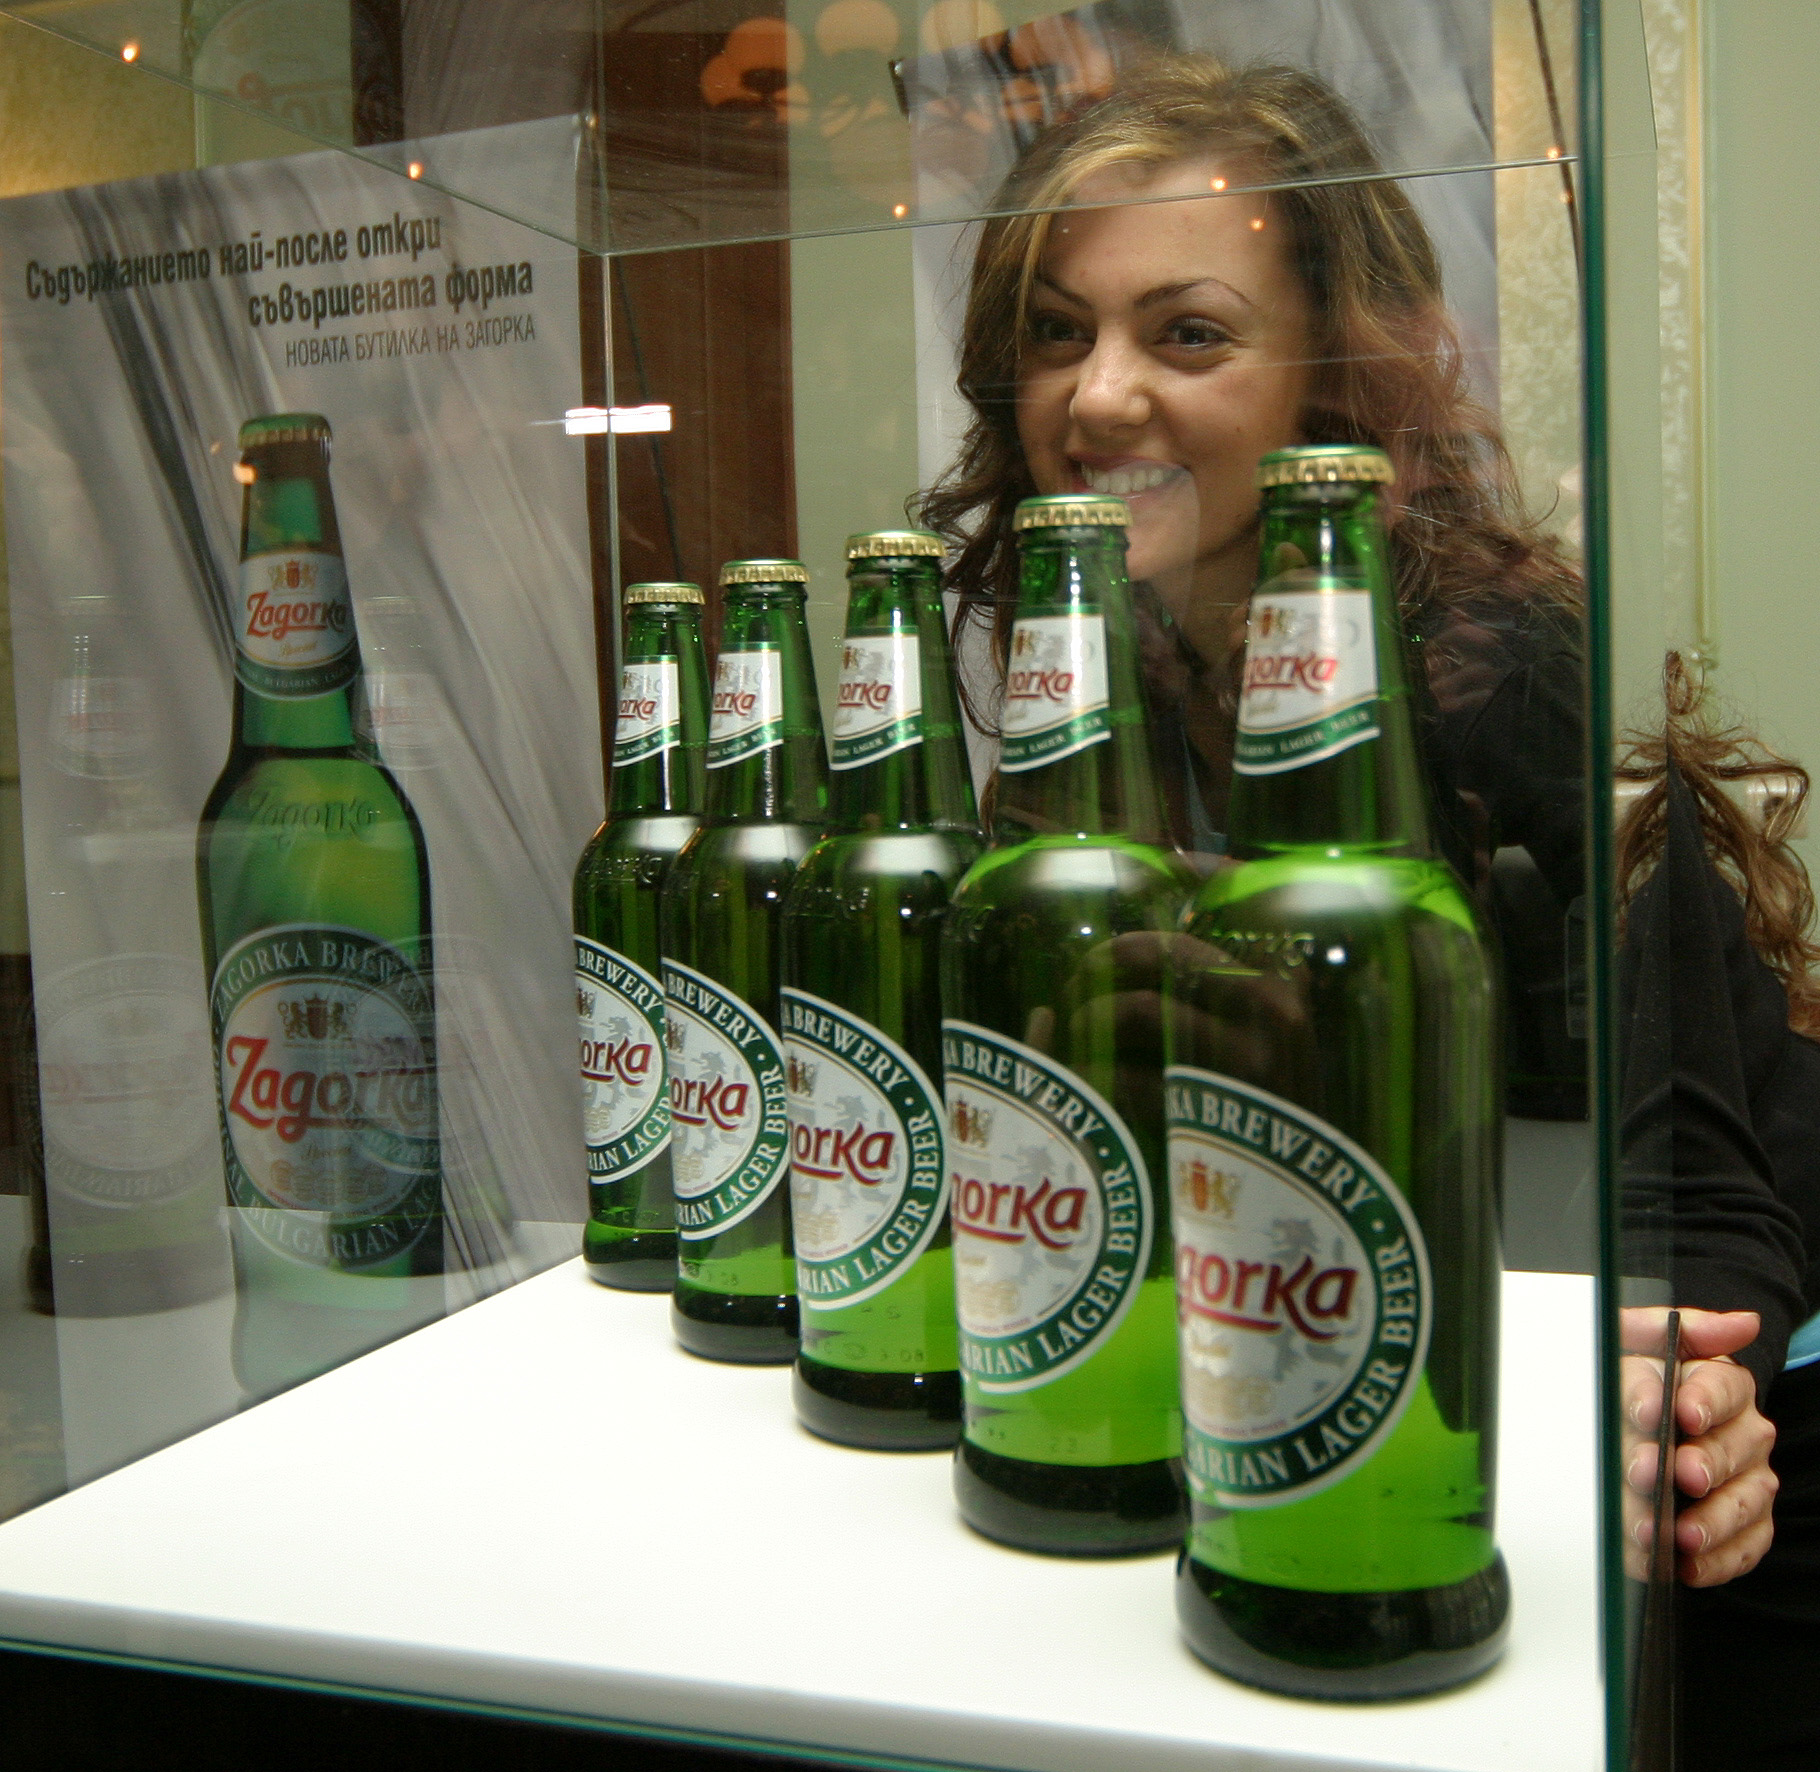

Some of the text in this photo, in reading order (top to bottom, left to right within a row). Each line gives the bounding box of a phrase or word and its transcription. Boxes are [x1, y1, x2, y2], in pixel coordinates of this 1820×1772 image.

[26, 212, 440, 305] Съдържанието най-после откри
[249, 260, 533, 330] съвършената форма
[286, 313, 536, 368] НОВАТА БУТИЛКА НА ЗАГОРКА
[247, 591, 346, 641] Zagorka
[578, 948, 664, 1014] BREWERY
[579, 1037, 653, 1087] orka
[667, 973, 787, 1135] BREWERY BEER
[793, 1004, 940, 1192] BREWERY BEER
[714, 1142, 780, 1214] LAGER
[789, 1122, 896, 1186] orka
[962, 1041, 1138, 1257] BREWERY BEER
[853, 1199, 930, 1282] LAGER
[1201, 1091, 1378, 1216] BREWERY
[1376, 1237, 1413, 1349] BEER
[1037, 1265, 1127, 1360] LAGER
[1295, 1360, 1404, 1471] LAGER
